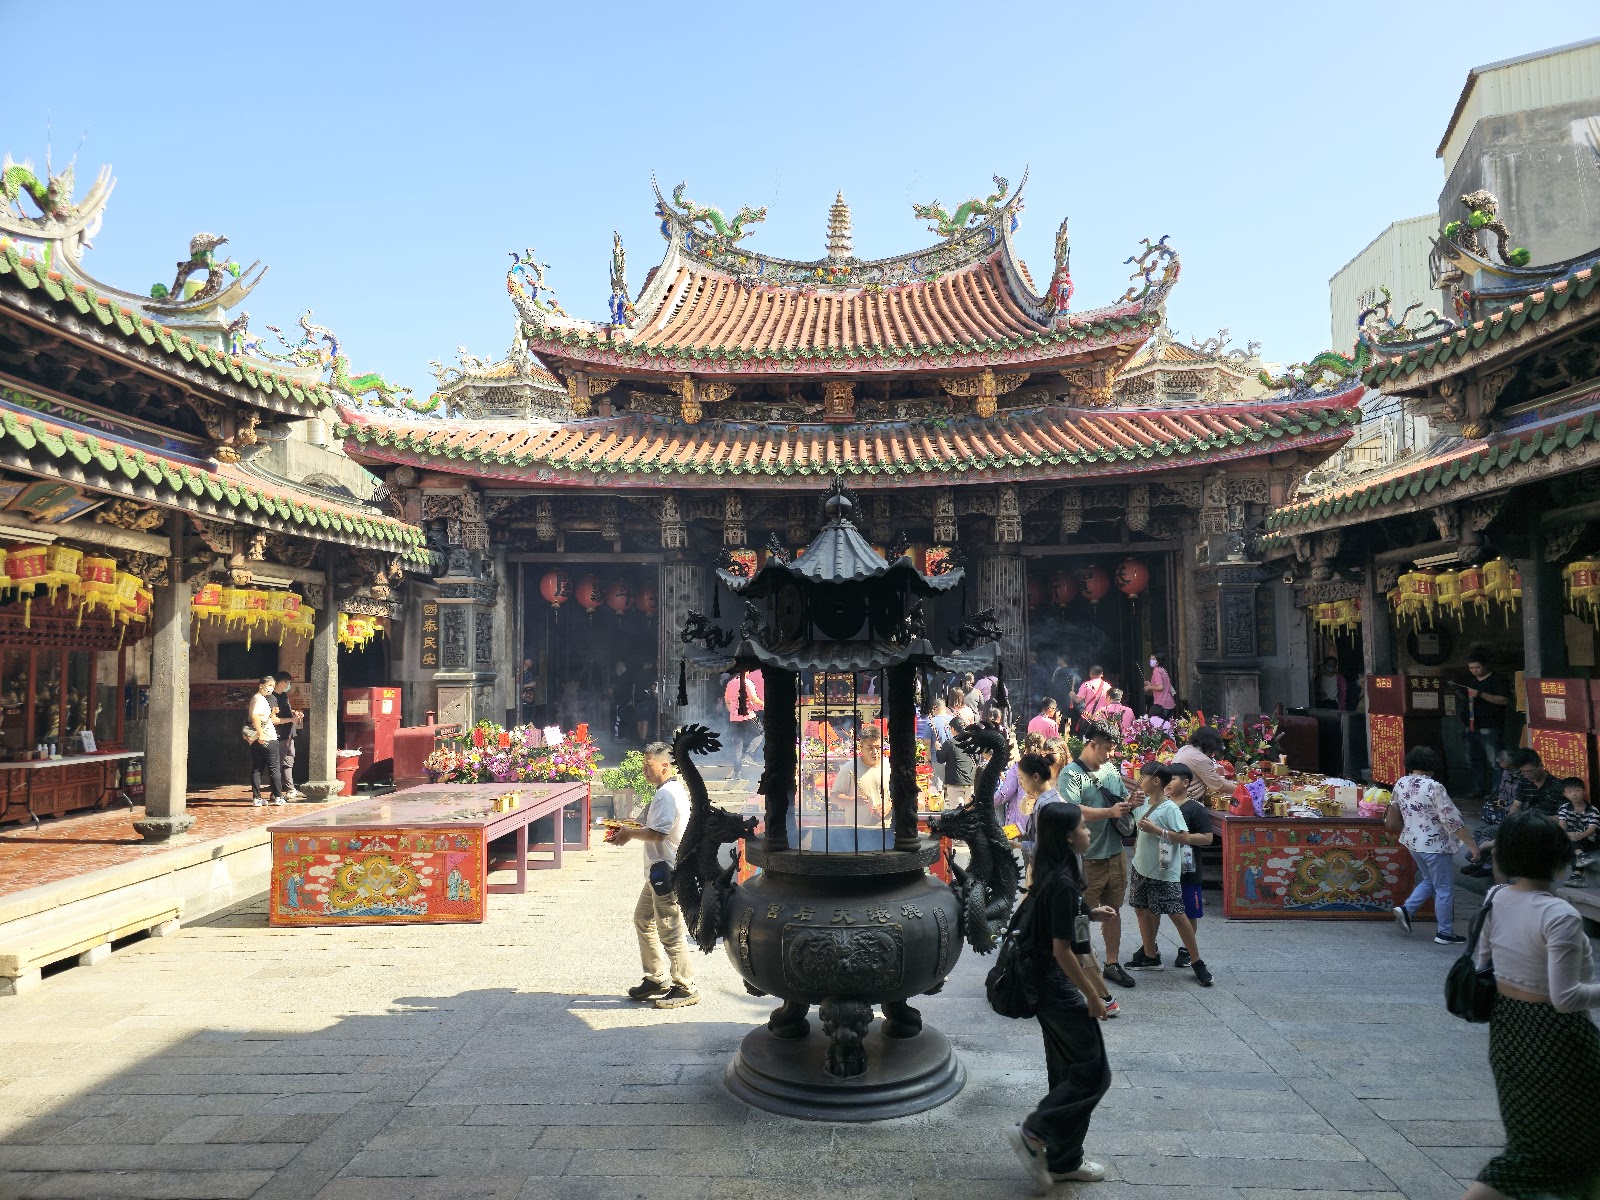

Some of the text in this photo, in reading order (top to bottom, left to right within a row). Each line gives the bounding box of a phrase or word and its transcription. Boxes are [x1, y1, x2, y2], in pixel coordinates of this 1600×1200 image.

[422, 603, 439, 665] 國泰民安
[1410, 678, 1440, 689] 點香台
[1540, 682, 1566, 695] 點香台
